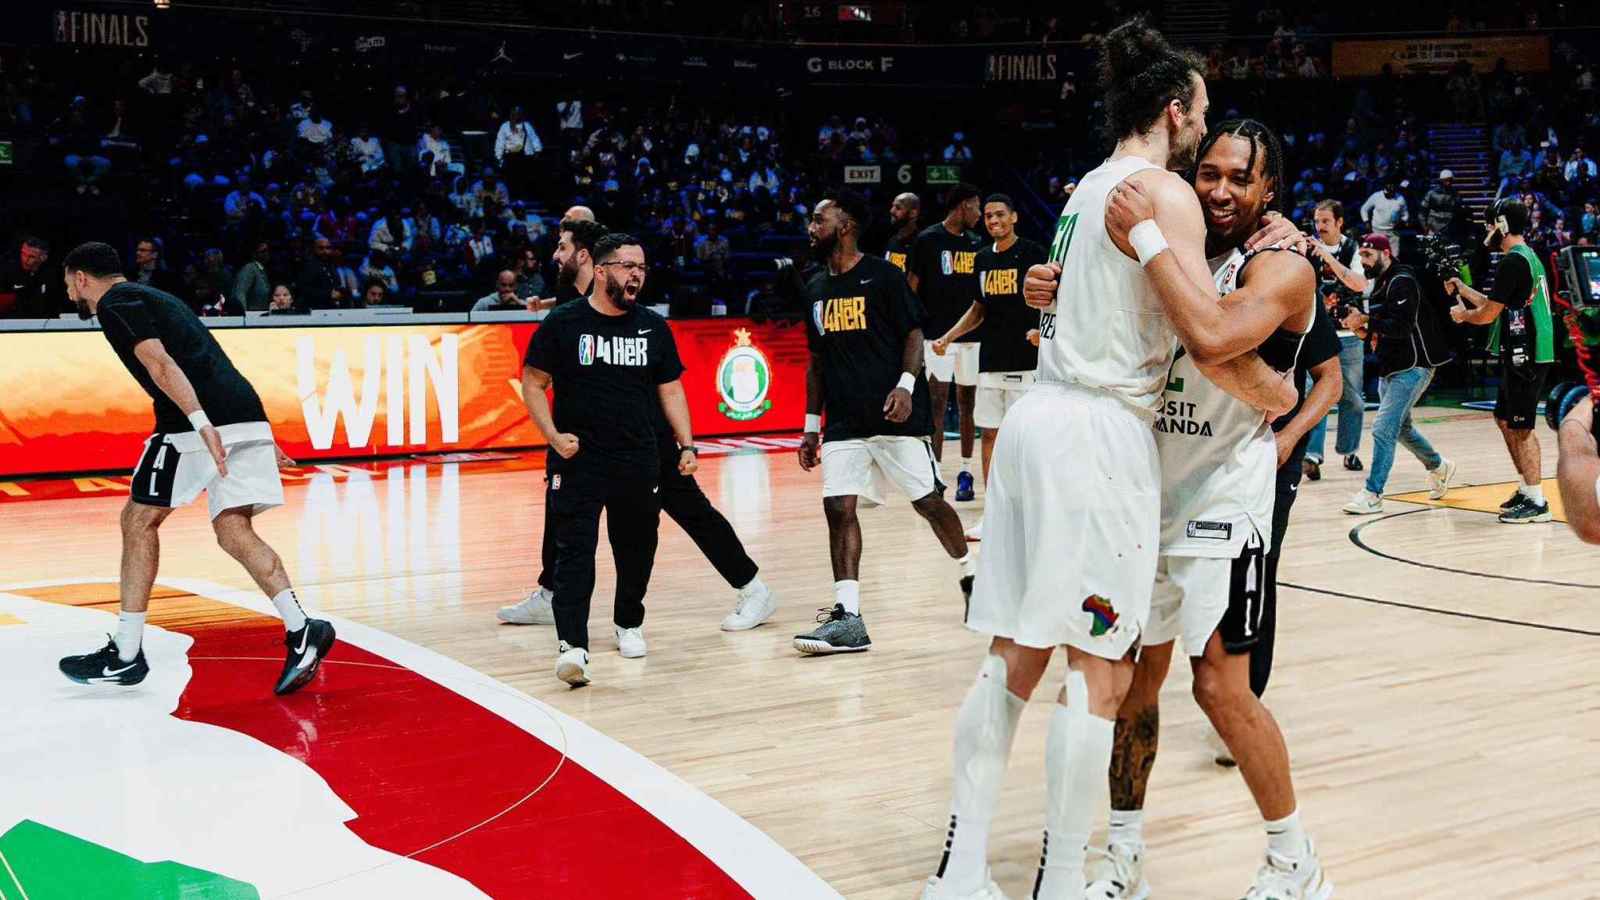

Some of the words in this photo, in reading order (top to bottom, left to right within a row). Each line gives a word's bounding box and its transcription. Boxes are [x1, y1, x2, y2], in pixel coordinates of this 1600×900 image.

[70, 11, 149, 47] FINALS
[807, 57, 823, 73] G
[828, 59, 875, 71] BLOCK
[881, 56, 895, 73] F
[998, 54, 1057, 81] FINALS
[848, 169, 875, 179] EXIT
[896, 164, 913, 184] 6
[297, 333, 459, 450] WIN
[1154, 416, 1214, 437] ANDA
